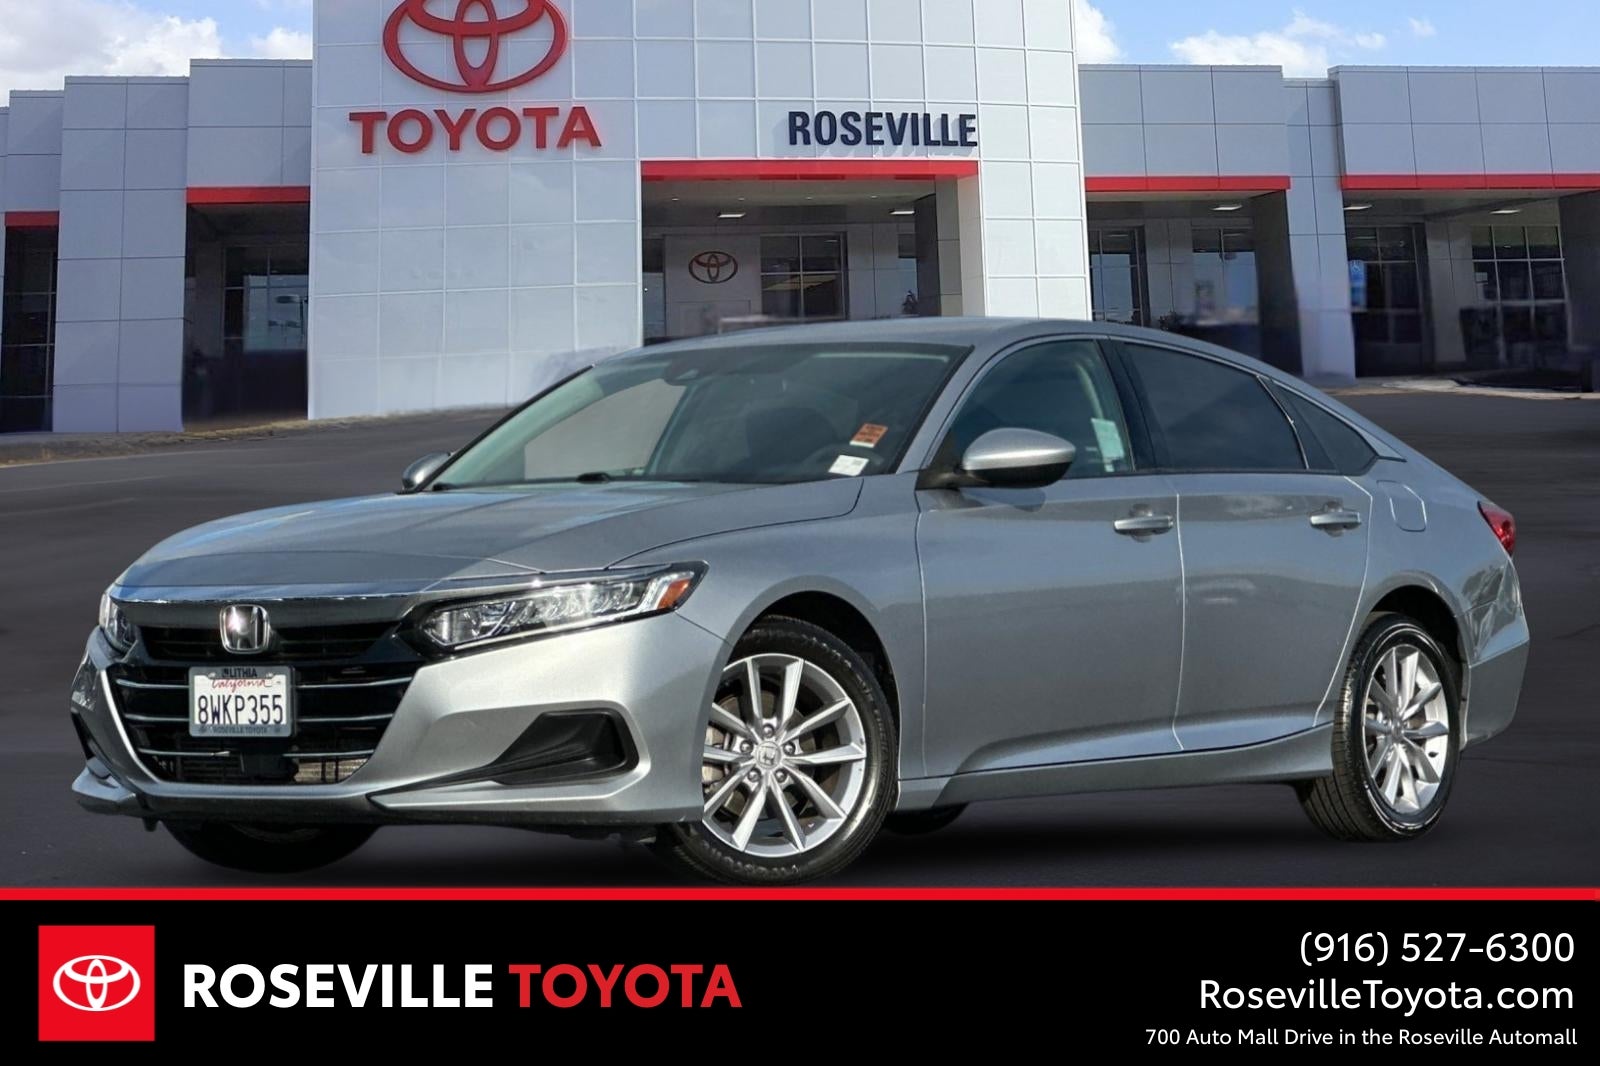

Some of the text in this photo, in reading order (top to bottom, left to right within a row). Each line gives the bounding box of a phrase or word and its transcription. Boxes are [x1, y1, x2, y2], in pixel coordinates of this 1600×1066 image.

[349, 106, 602, 154] TOYOTA
[788, 110, 978, 147] ROSEVILLE
[211, 678, 273, 693] California
[229, 667, 258, 678] LITHIA
[197, 694, 284, 725] 8WKP355
